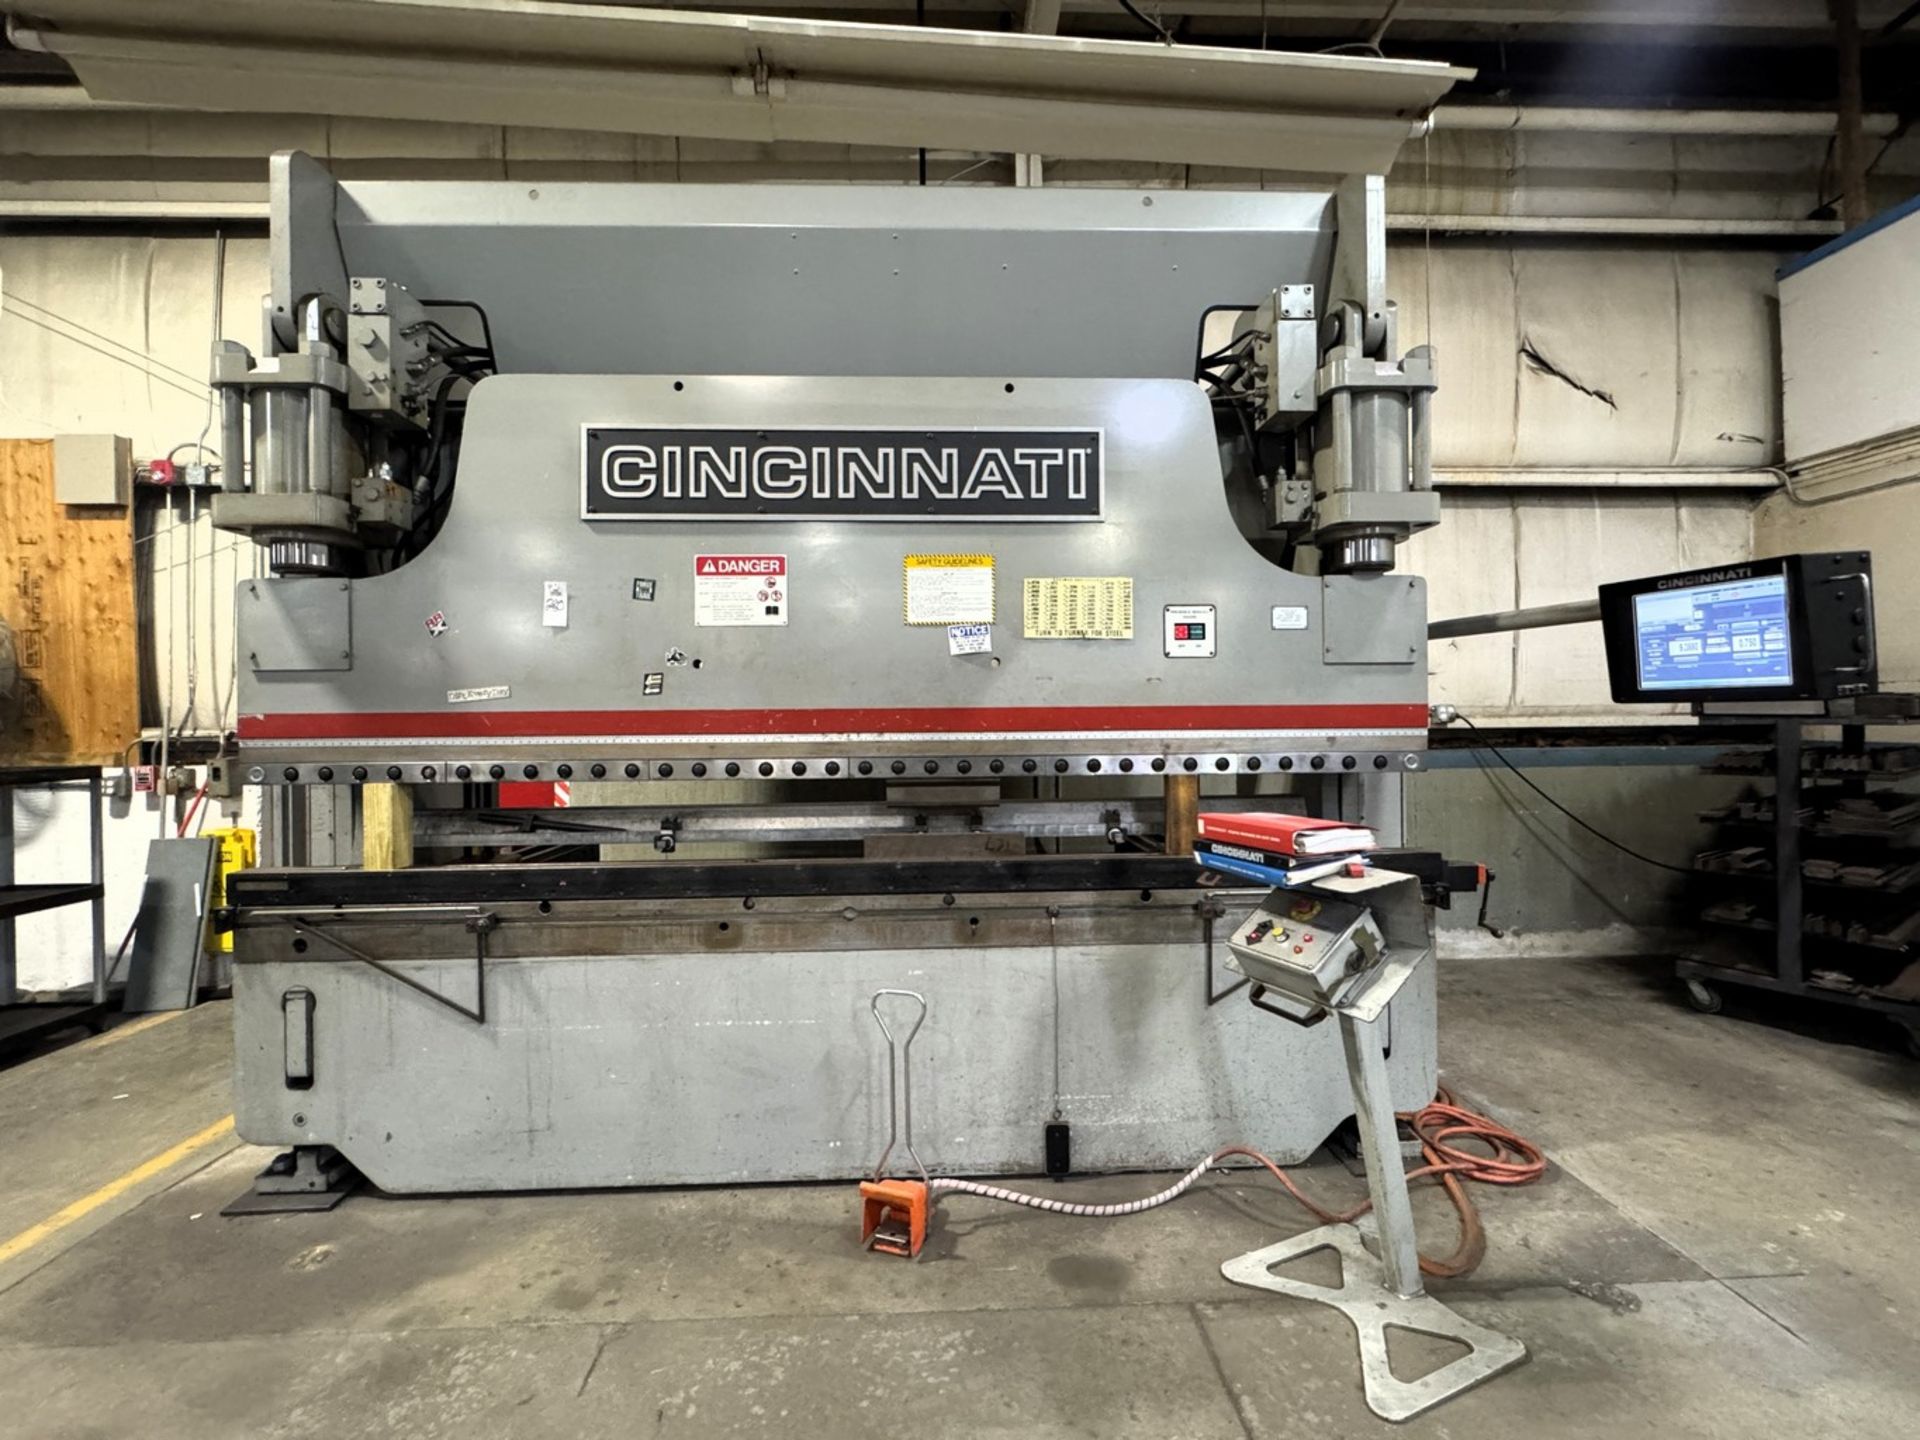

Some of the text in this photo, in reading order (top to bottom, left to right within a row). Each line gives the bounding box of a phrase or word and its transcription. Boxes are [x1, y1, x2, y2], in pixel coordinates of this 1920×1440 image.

[601, 445, 1087, 499] CINCINNATI
[718, 559, 780, 573] DANGER
[916, 558, 984, 566] SAFETY GUIDELINES
[1657, 567, 1752, 590] CINCINNATI
[950, 625, 988, 638] NOTICE
